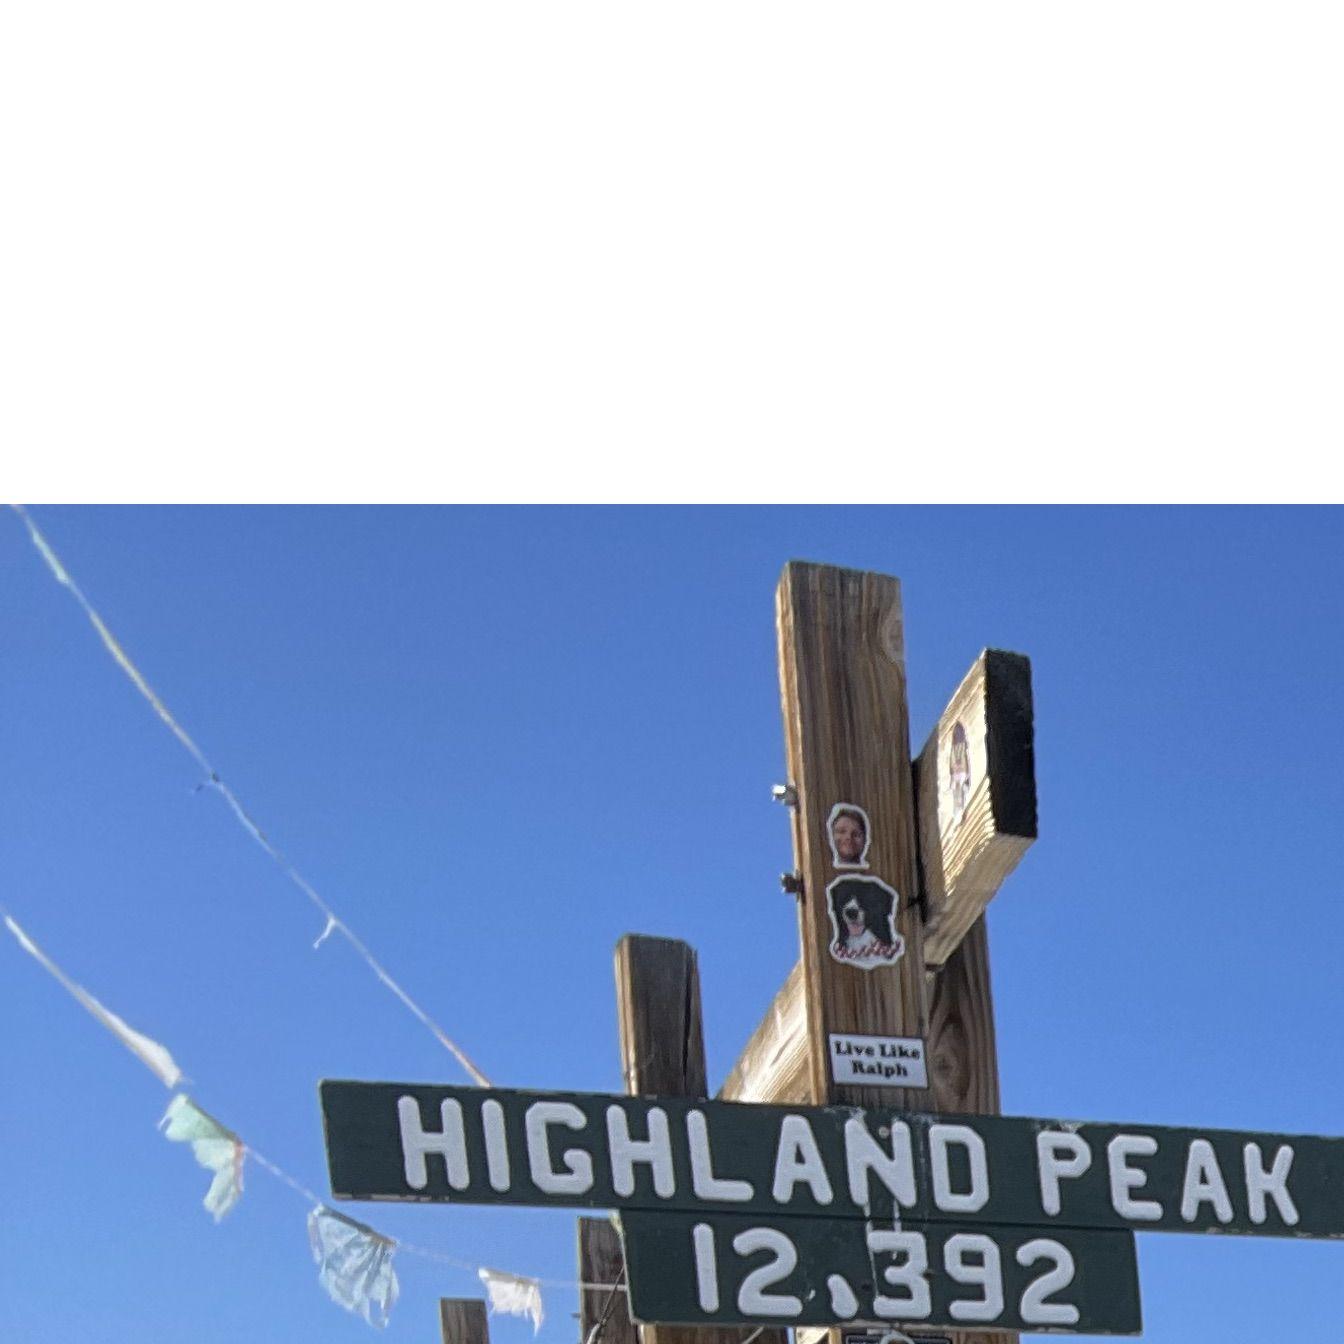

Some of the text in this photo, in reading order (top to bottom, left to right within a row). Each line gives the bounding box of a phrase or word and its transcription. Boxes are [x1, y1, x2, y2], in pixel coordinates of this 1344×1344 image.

[834, 1040, 920, 1060] Live Like
[851, 1060, 908, 1078] Ralph
[397, 1095, 1299, 1226] HIGHLAND PEAK
[693, 1222, 1079, 1324] 12,392
